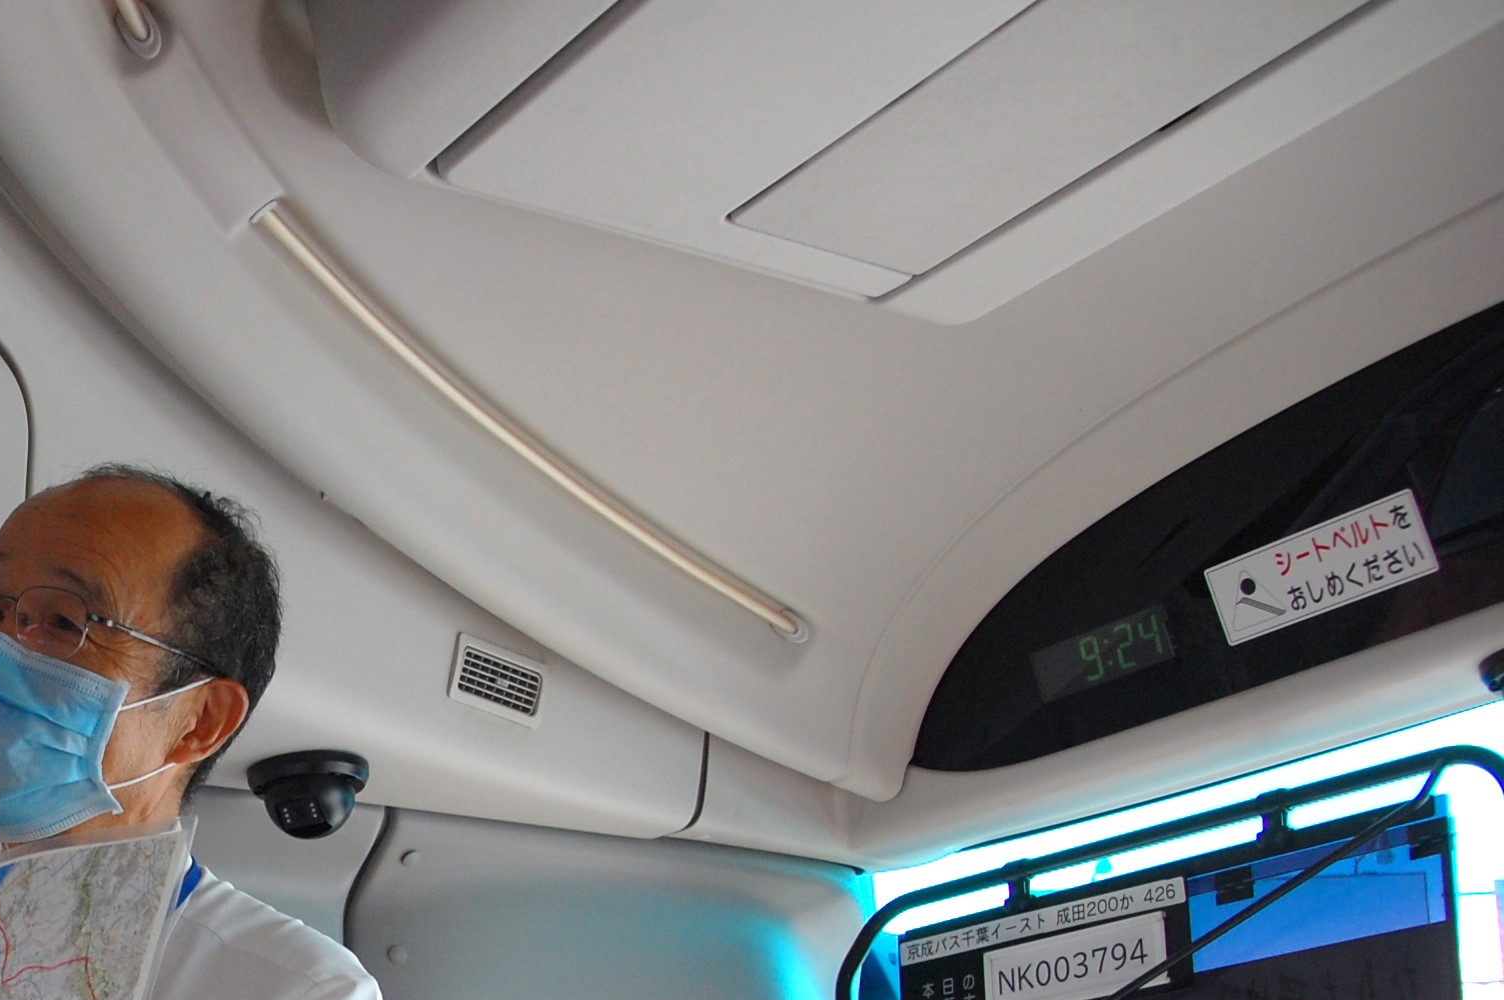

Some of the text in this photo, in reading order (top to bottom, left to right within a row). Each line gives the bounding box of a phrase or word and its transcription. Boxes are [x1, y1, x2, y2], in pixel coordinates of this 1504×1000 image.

[1274, 505, 1412, 576] シートベルトを
[1287, 541, 1425, 611] おしめください
[1078, 613, 1164, 682] 9:24
[906, 883, 1177, 962] 京成バス千葉イースト 成田200か 426
[921, 973, 976, 999] 本日の
[998, 938, 1149, 996] NK003794
